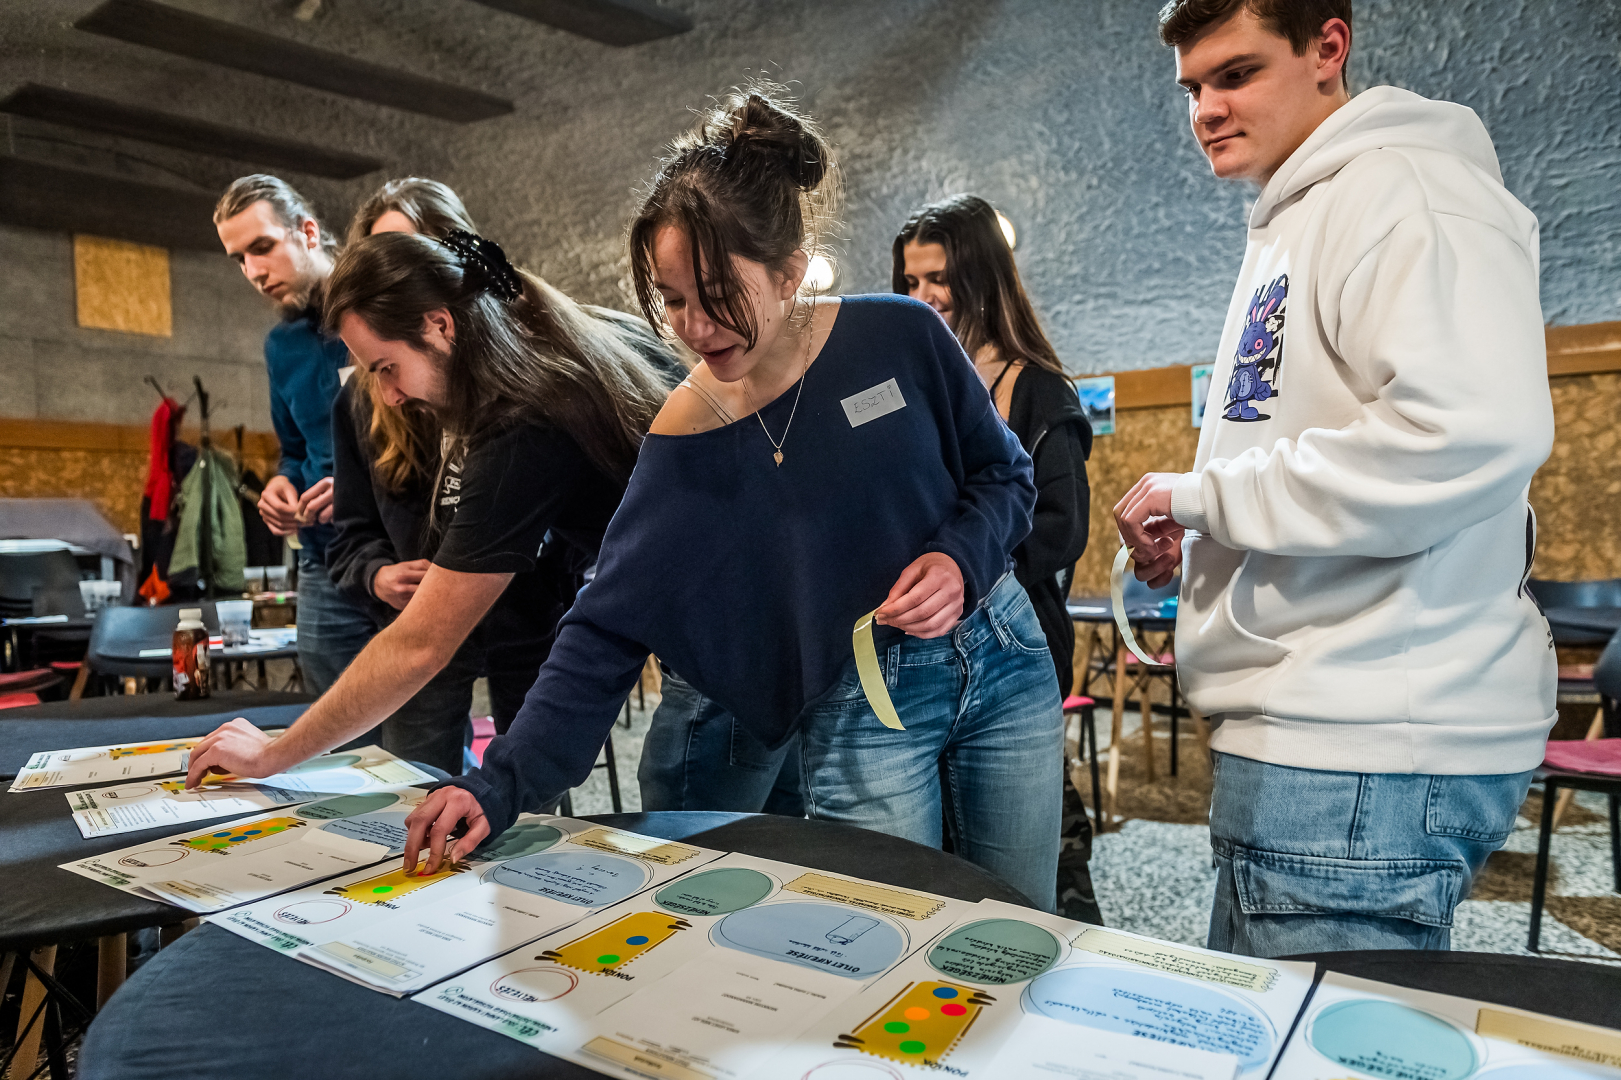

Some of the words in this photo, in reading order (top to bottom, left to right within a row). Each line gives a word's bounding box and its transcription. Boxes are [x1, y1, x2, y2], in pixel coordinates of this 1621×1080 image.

[661, 900, 710, 916] NEHÉZSÉGEK
[784, 949, 833, 965] KIFEJTÉSE
[599, 967, 634, 981] PONTOK
[831, 961, 860, 972] ÖTLET
[941, 964, 1007, 984] NEHÉZSÉGEK
[493, 984, 538, 1003] HELYEZÉS
